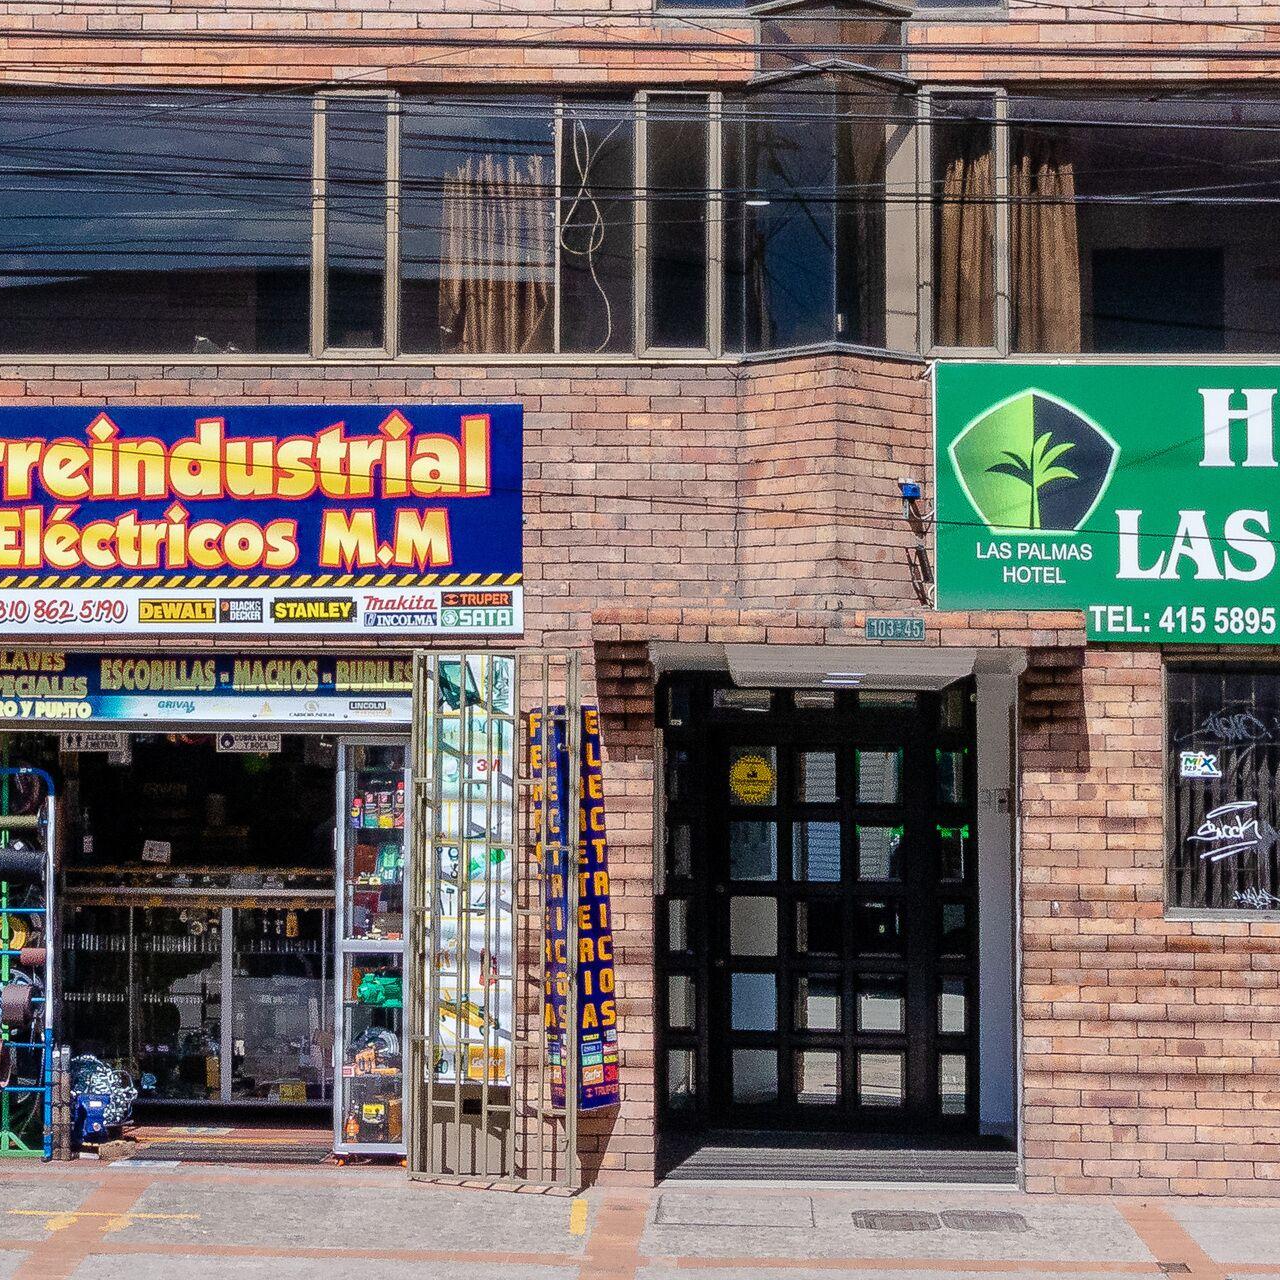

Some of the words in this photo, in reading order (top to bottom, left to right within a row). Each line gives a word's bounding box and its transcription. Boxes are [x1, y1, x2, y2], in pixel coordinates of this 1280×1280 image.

[319, 507, 453, 572] M.M
[1115, 508, 1277, 581] LAS
[976, 542, 1012, 560] LAS
[1018, 543, 1093, 561] PALMAS
[1003, 566, 1066, 584] HOTEL
[460, 593, 509, 605] TRUPER
[33, 599, 76, 624] 862
[77, 599, 129, 625] 5190
[230, 611, 261, 621] DECKER
[275, 602, 352, 618] STANLEY
[459, 609, 511, 626] SATA
[1089, 606, 1151, 633] TEL:
[1159, 606, 1206, 634] 415
[1214, 607, 1276, 634] 5895
[100, 658, 216, 693] ESCOBILLAS
[232, 658, 319, 693] MACHOS
[19, 700, 34, 718] Y
[35, 700, 93, 719] PUNTO
[350, 701, 385, 710] LINCOLN
